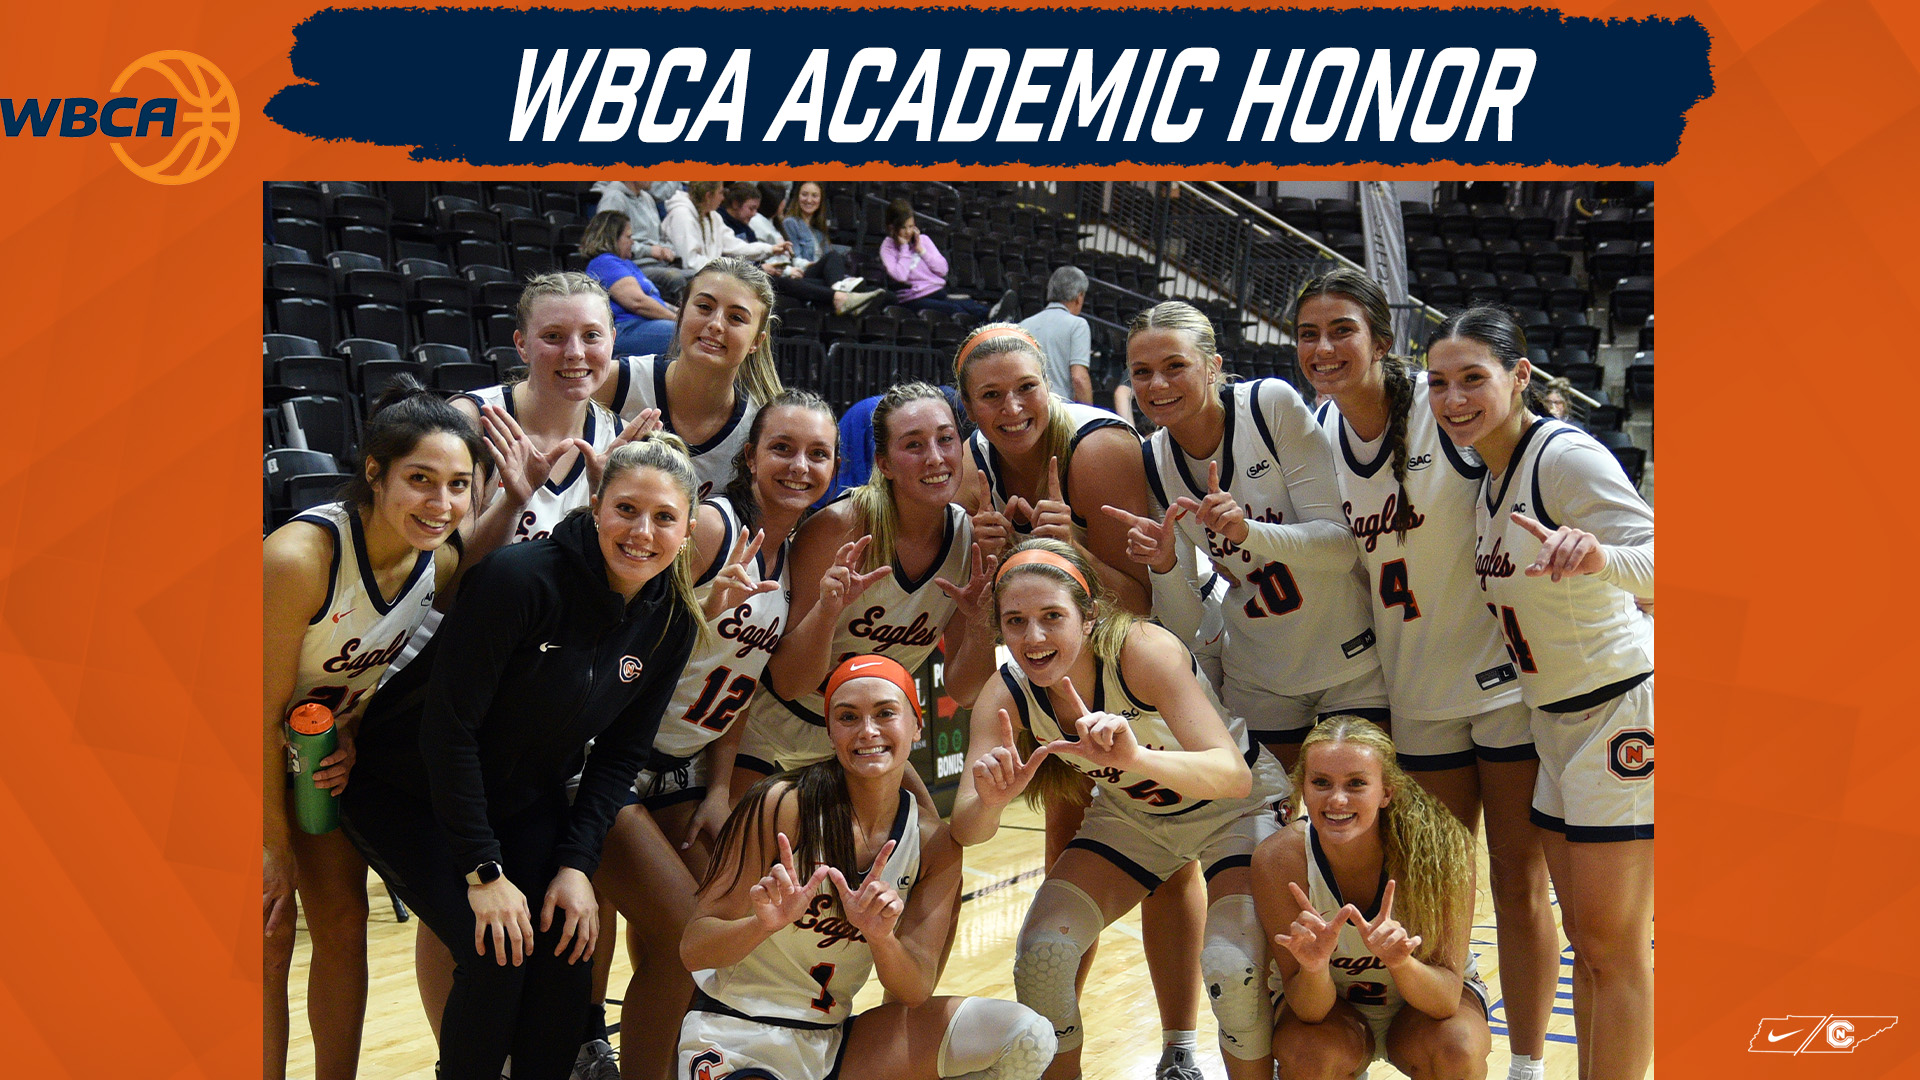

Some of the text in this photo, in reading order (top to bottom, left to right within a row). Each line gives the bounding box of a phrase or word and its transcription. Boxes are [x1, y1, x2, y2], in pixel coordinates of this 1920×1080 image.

[1248, 459, 1270, 477] SAC
[1408, 453, 1432, 468] SAC
[1379, 557, 1422, 623] 4
[717, 603, 781, 658] Eagle
[848, 605, 938, 653] Eagles
[681, 665, 757, 733] 12
[937, 752, 964, 779] BONUS
[1119, 779, 1183, 808] 5
[809, 962, 837, 1015] 1
